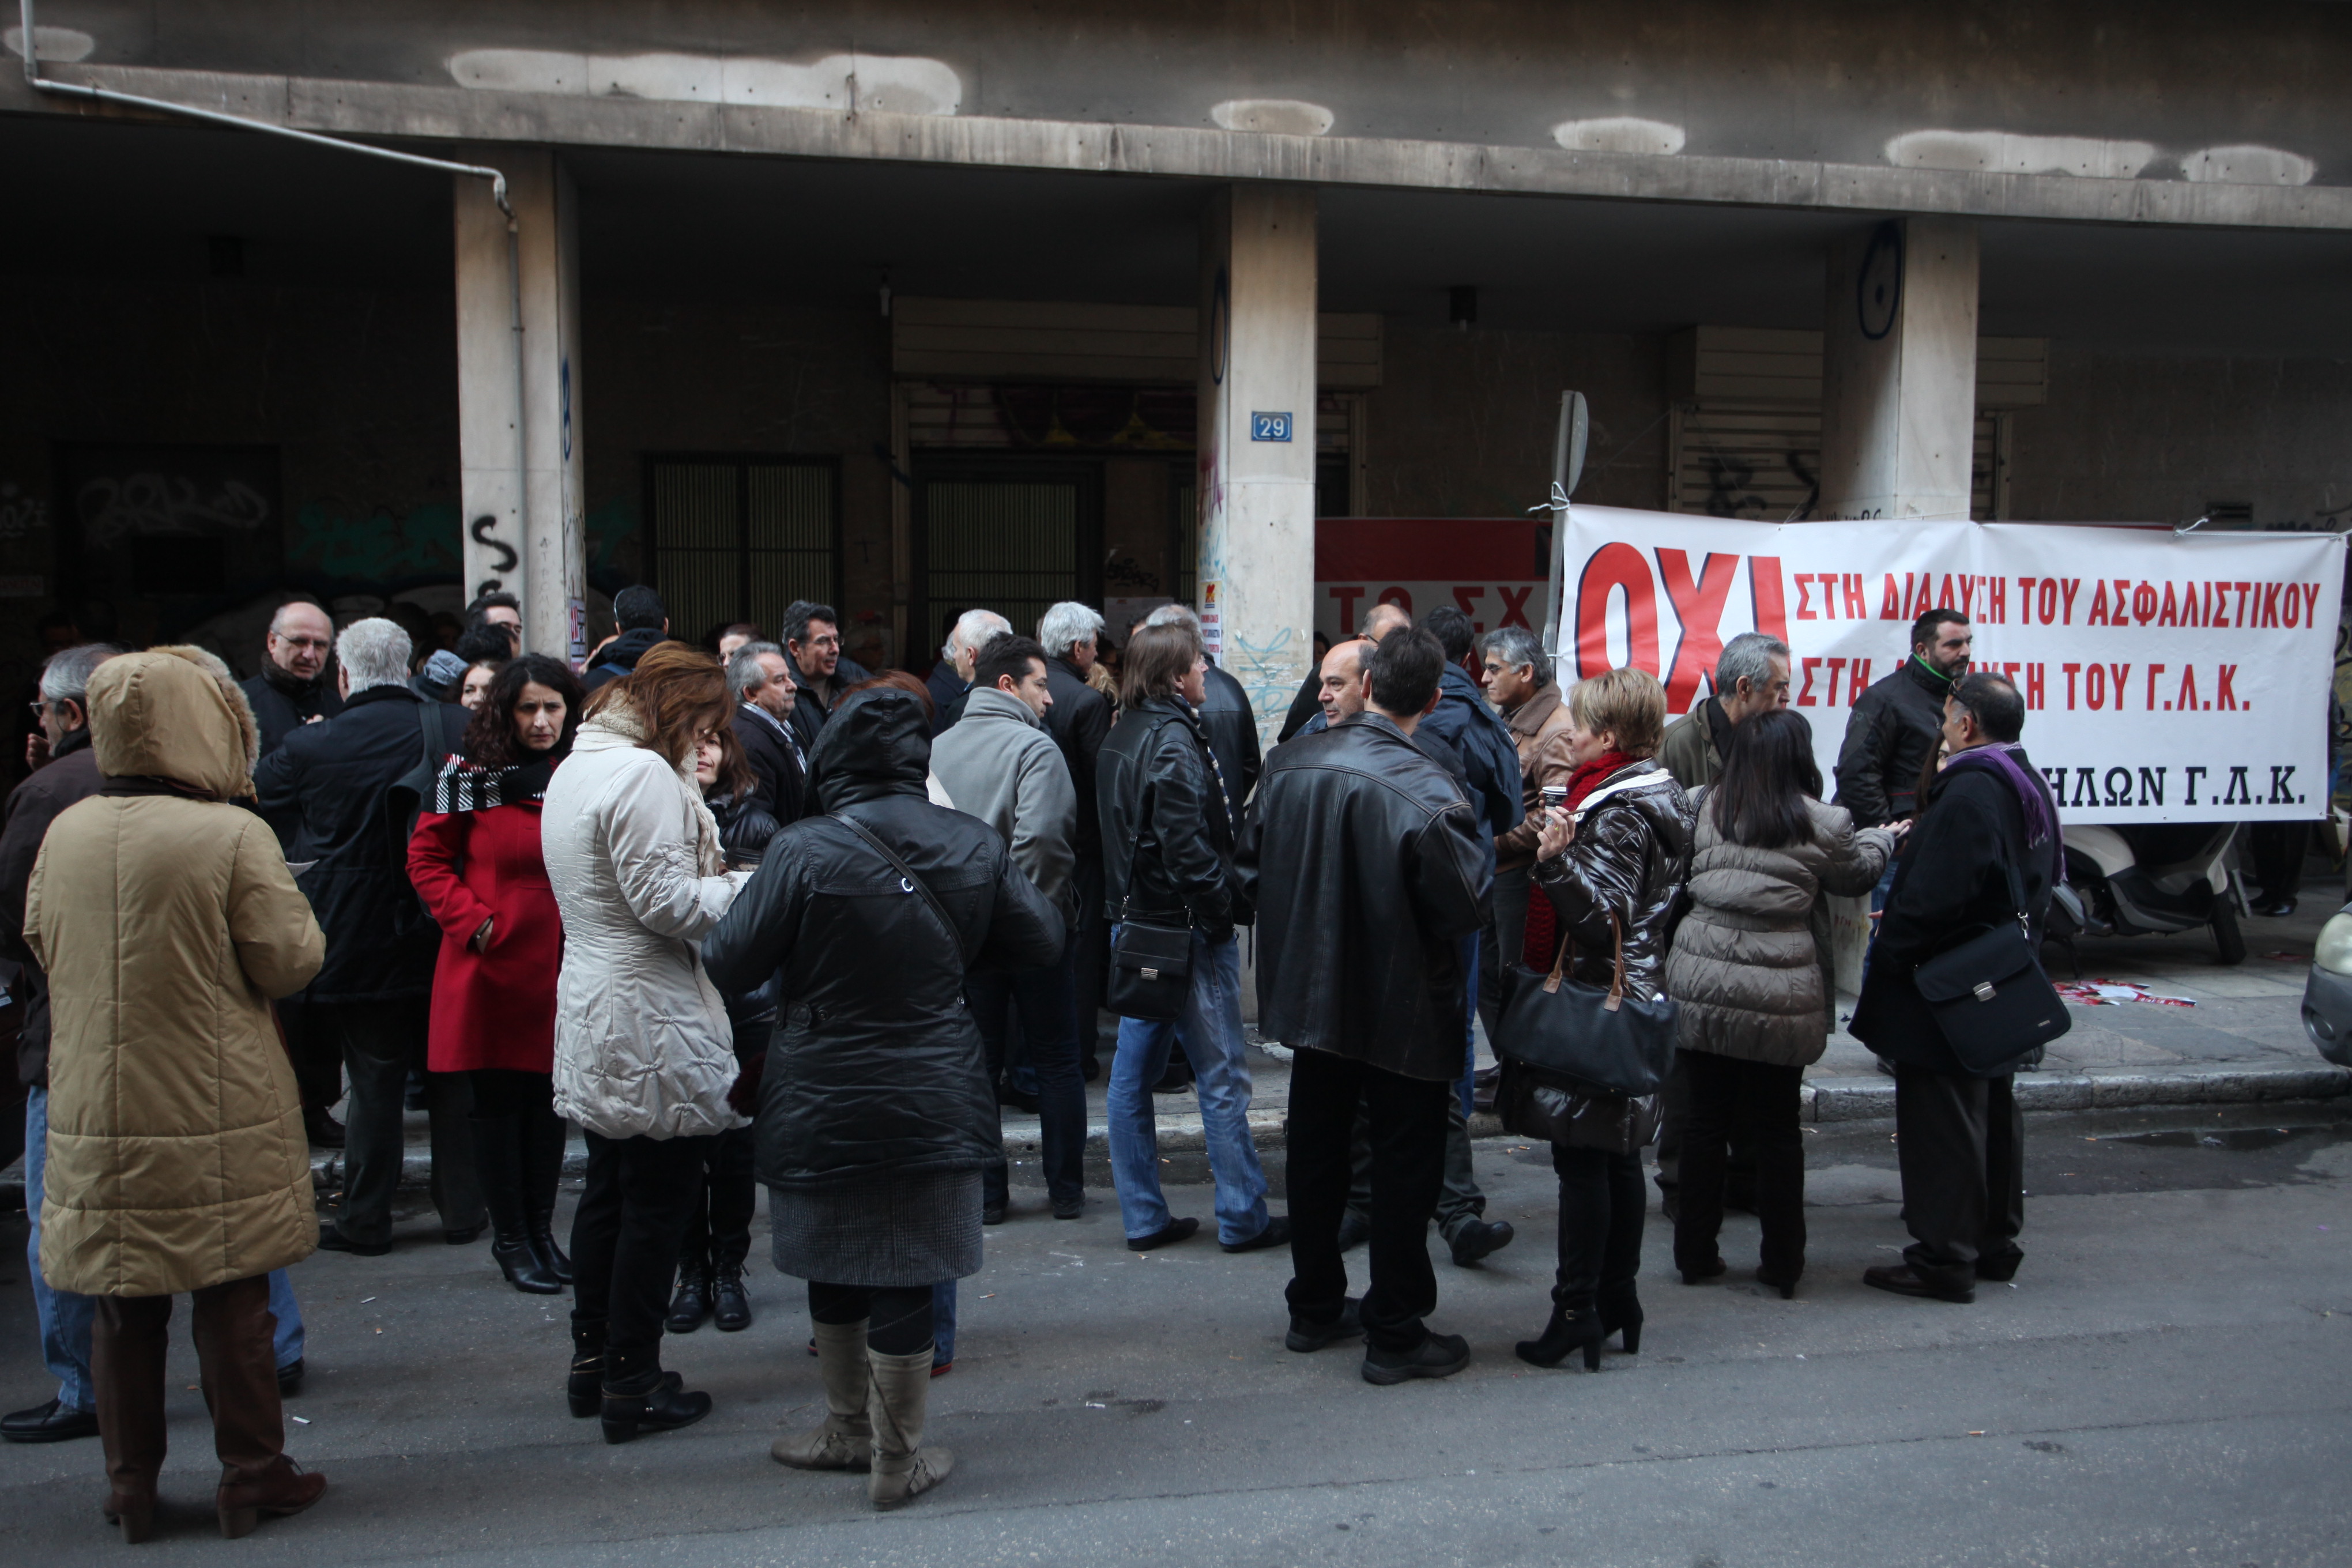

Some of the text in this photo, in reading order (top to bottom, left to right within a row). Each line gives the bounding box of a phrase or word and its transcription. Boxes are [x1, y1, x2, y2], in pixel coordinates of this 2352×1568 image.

[1260, 418, 1284, 436] 29
[1794, 572, 2320, 630] ΣΤΗ ΔΙΑΛΥΣΗ ΤΟΥ ΑΣΦΑΛΙΣΤΙΚΟΥ
[1797, 658, 1871, 707] ΣΤΗ
[2062, 663, 2131, 711] ΤΟΥ
[2146, 664, 2250, 711] Γ.Λ.Κ.
[2184, 766, 2305, 806] Γ.Λ.Κ.
